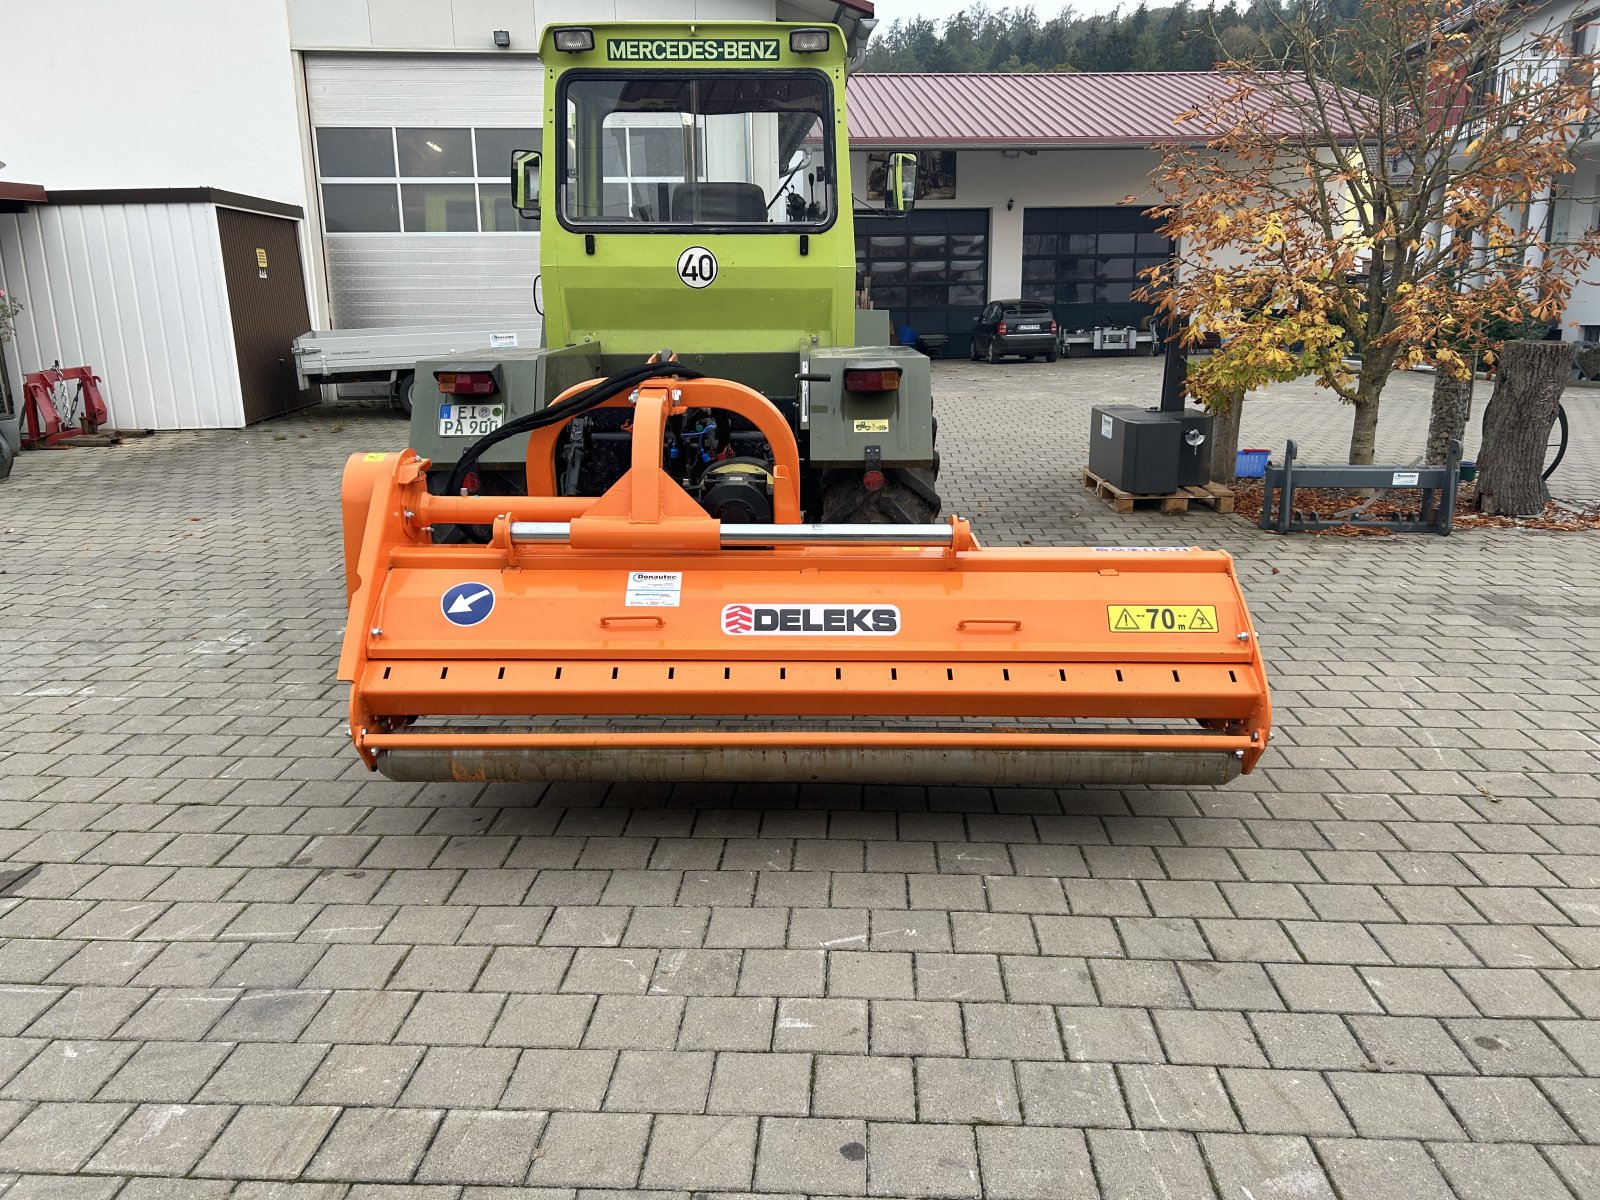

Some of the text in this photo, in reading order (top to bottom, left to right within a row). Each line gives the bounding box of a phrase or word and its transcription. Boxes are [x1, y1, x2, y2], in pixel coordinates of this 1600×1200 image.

[609, 40, 778, 59] MERCEDES-BENZ
[682, 254, 713, 281] 40
[458, 406, 477, 419] EI
[444, 421, 463, 434] PA
[754, 609, 897, 632] DELEKS
[1145, 608, 1175, 630] 70
